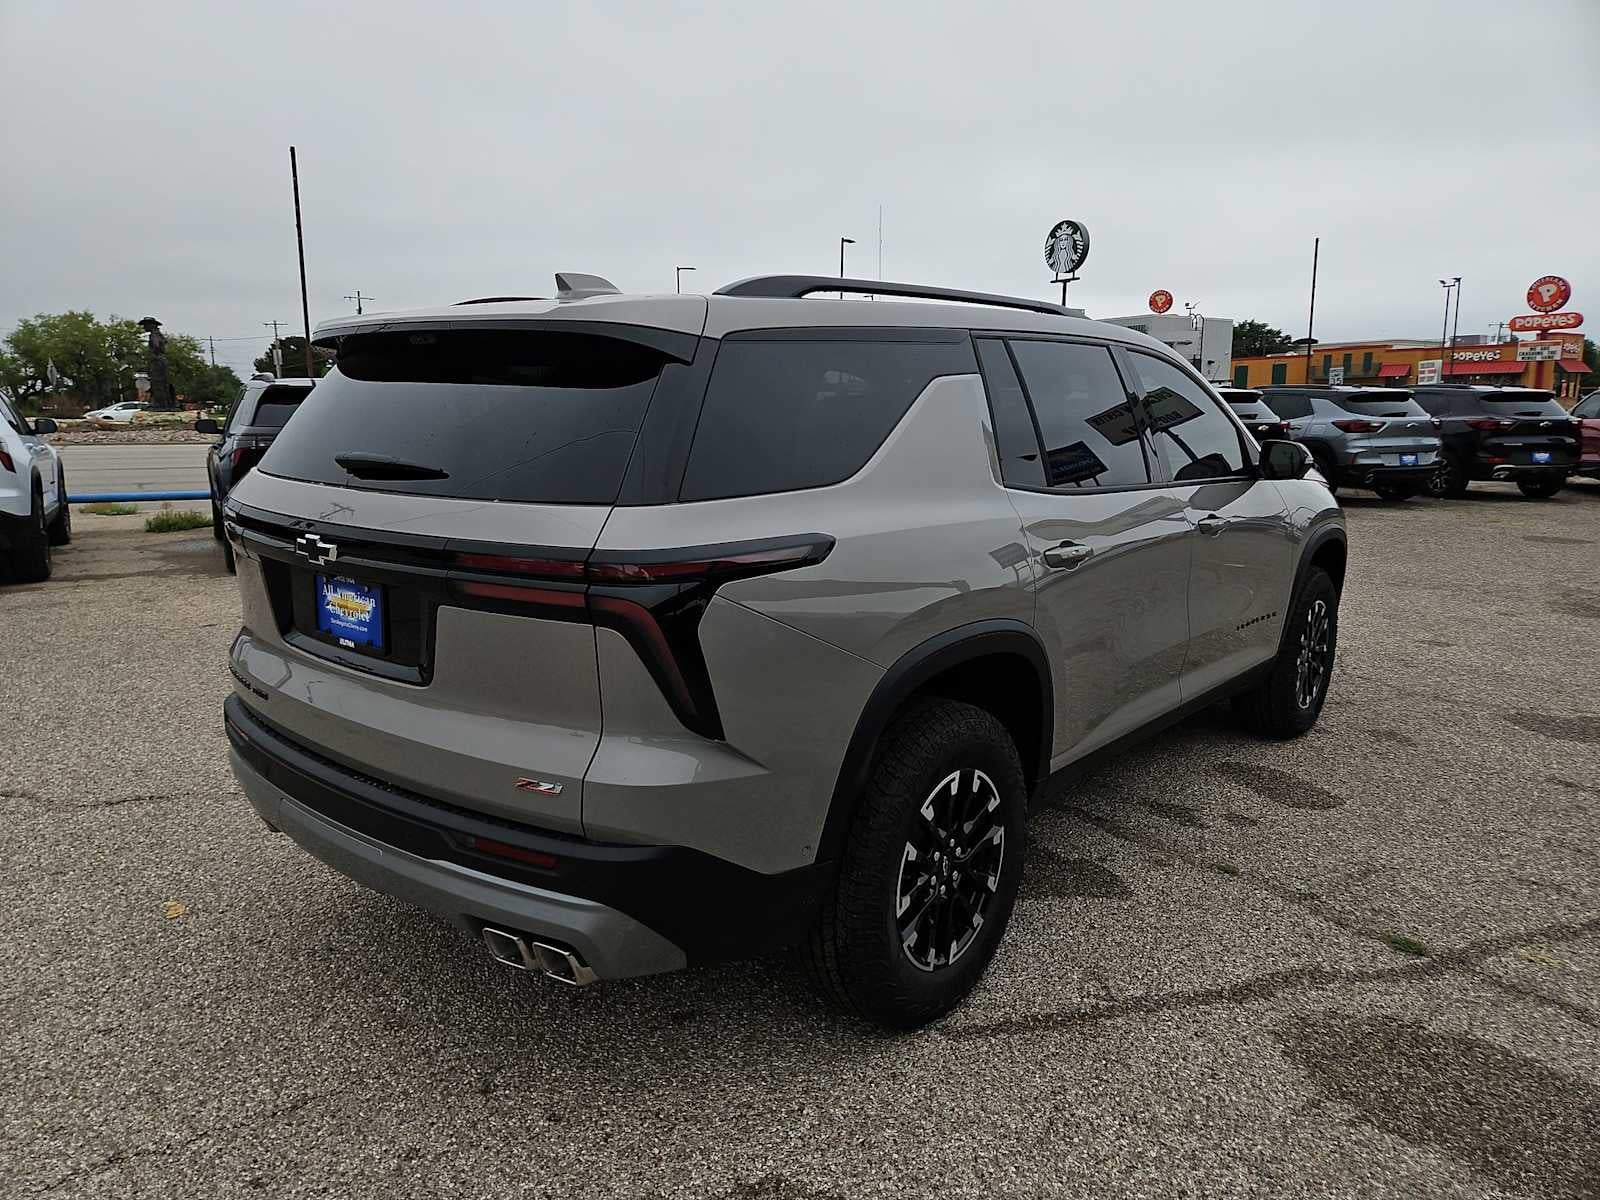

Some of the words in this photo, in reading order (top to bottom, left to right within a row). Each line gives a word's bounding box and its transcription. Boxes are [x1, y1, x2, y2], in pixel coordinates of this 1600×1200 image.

[1515, 314, 1576, 329] POPEYES
[322, 583, 335, 596] All
[336, 587, 376, 608] American
[329, 600, 370, 622] Chevrolet
